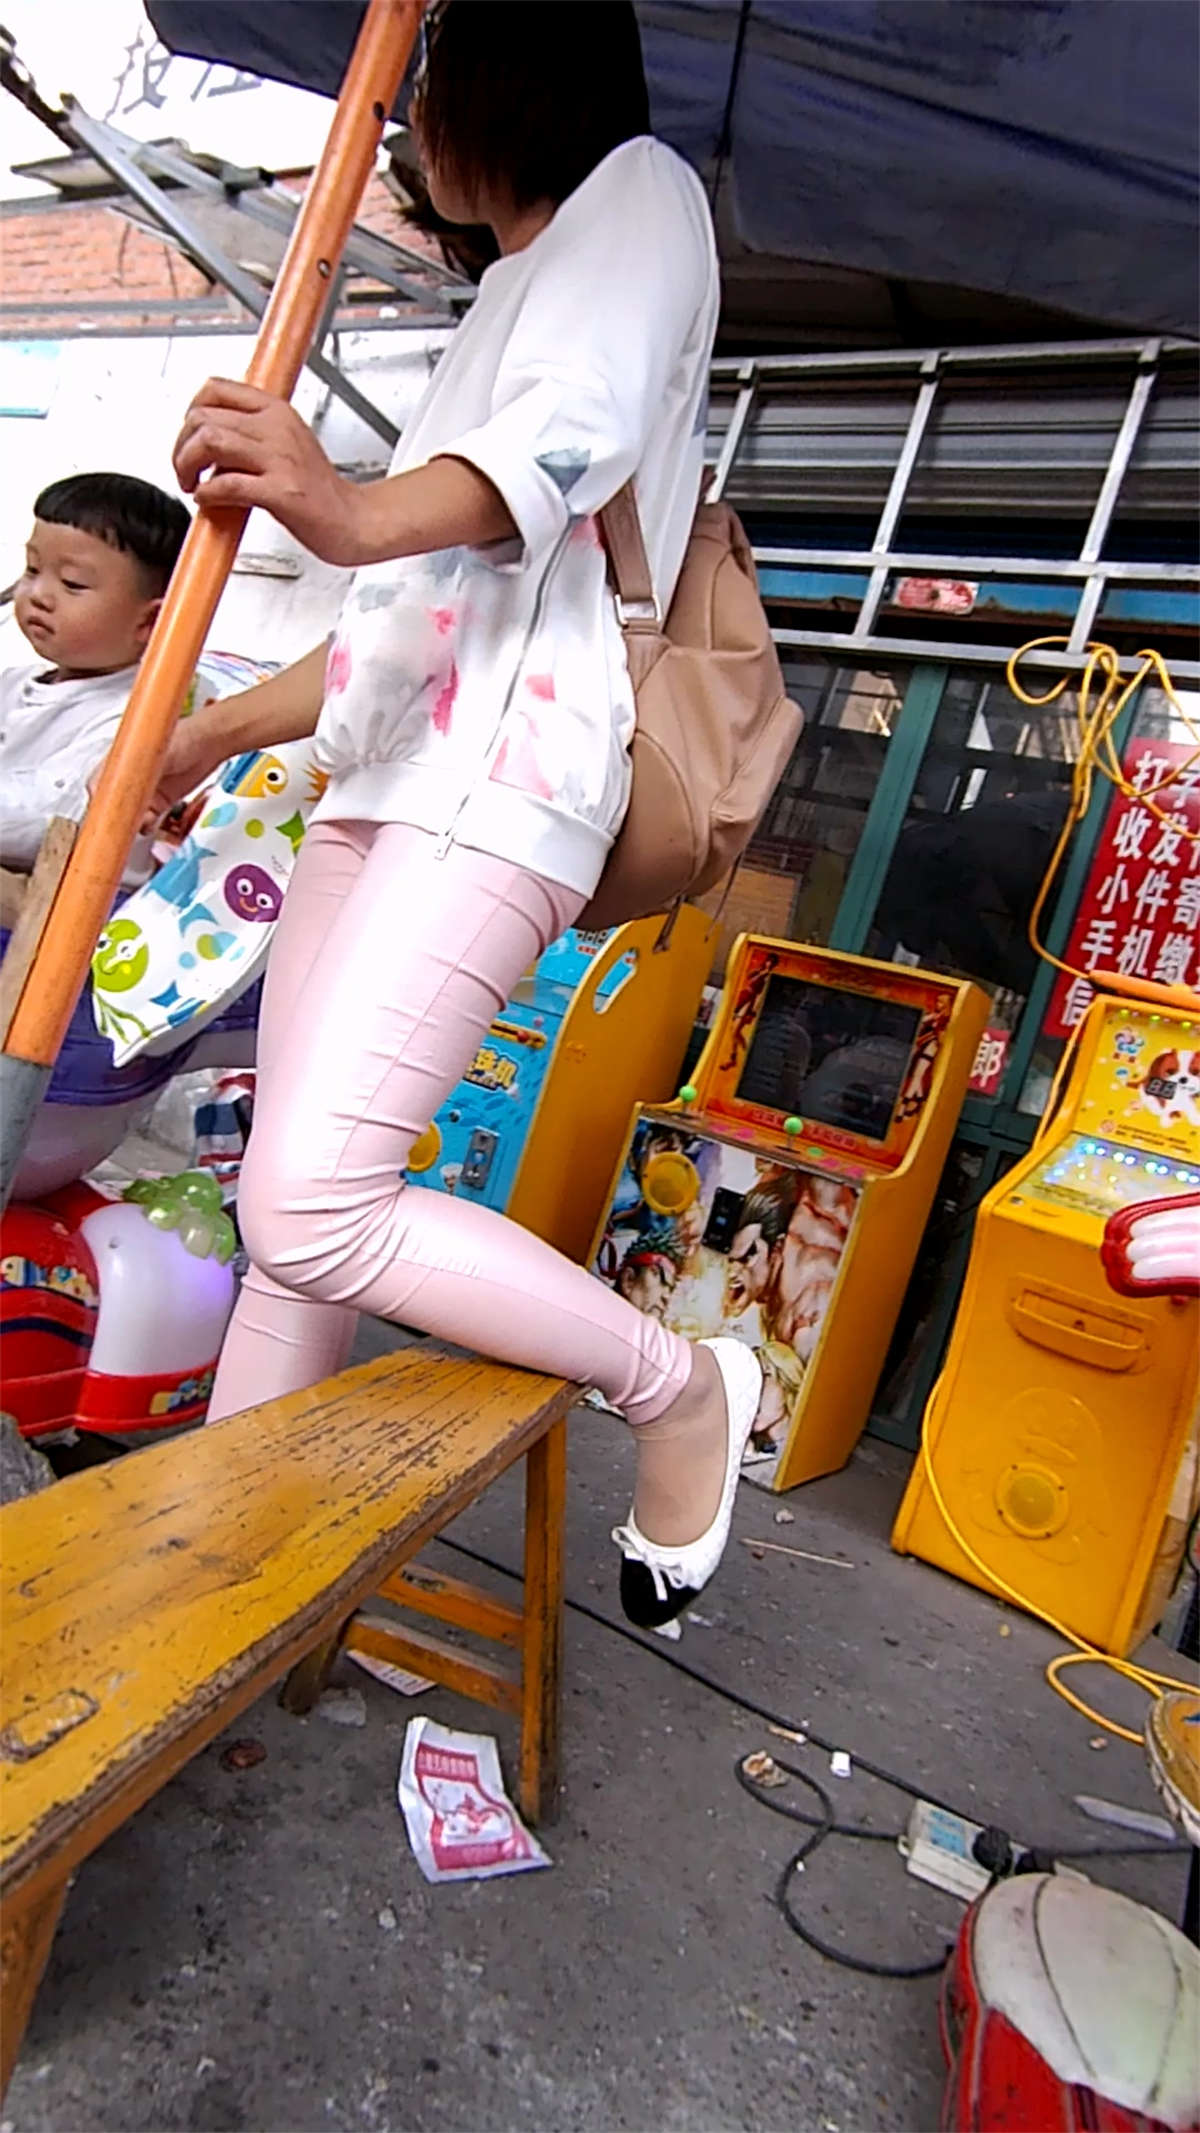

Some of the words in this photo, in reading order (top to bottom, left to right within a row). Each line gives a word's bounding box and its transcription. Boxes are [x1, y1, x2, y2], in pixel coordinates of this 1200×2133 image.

[1127, 750, 1200, 808] 打字
[1112, 806, 1200, 870] 收发
[1095, 863, 1200, 931] 小件寄
[1080, 919, 1200, 992] 手机缴
[1060, 976, 1094, 1026] 信
